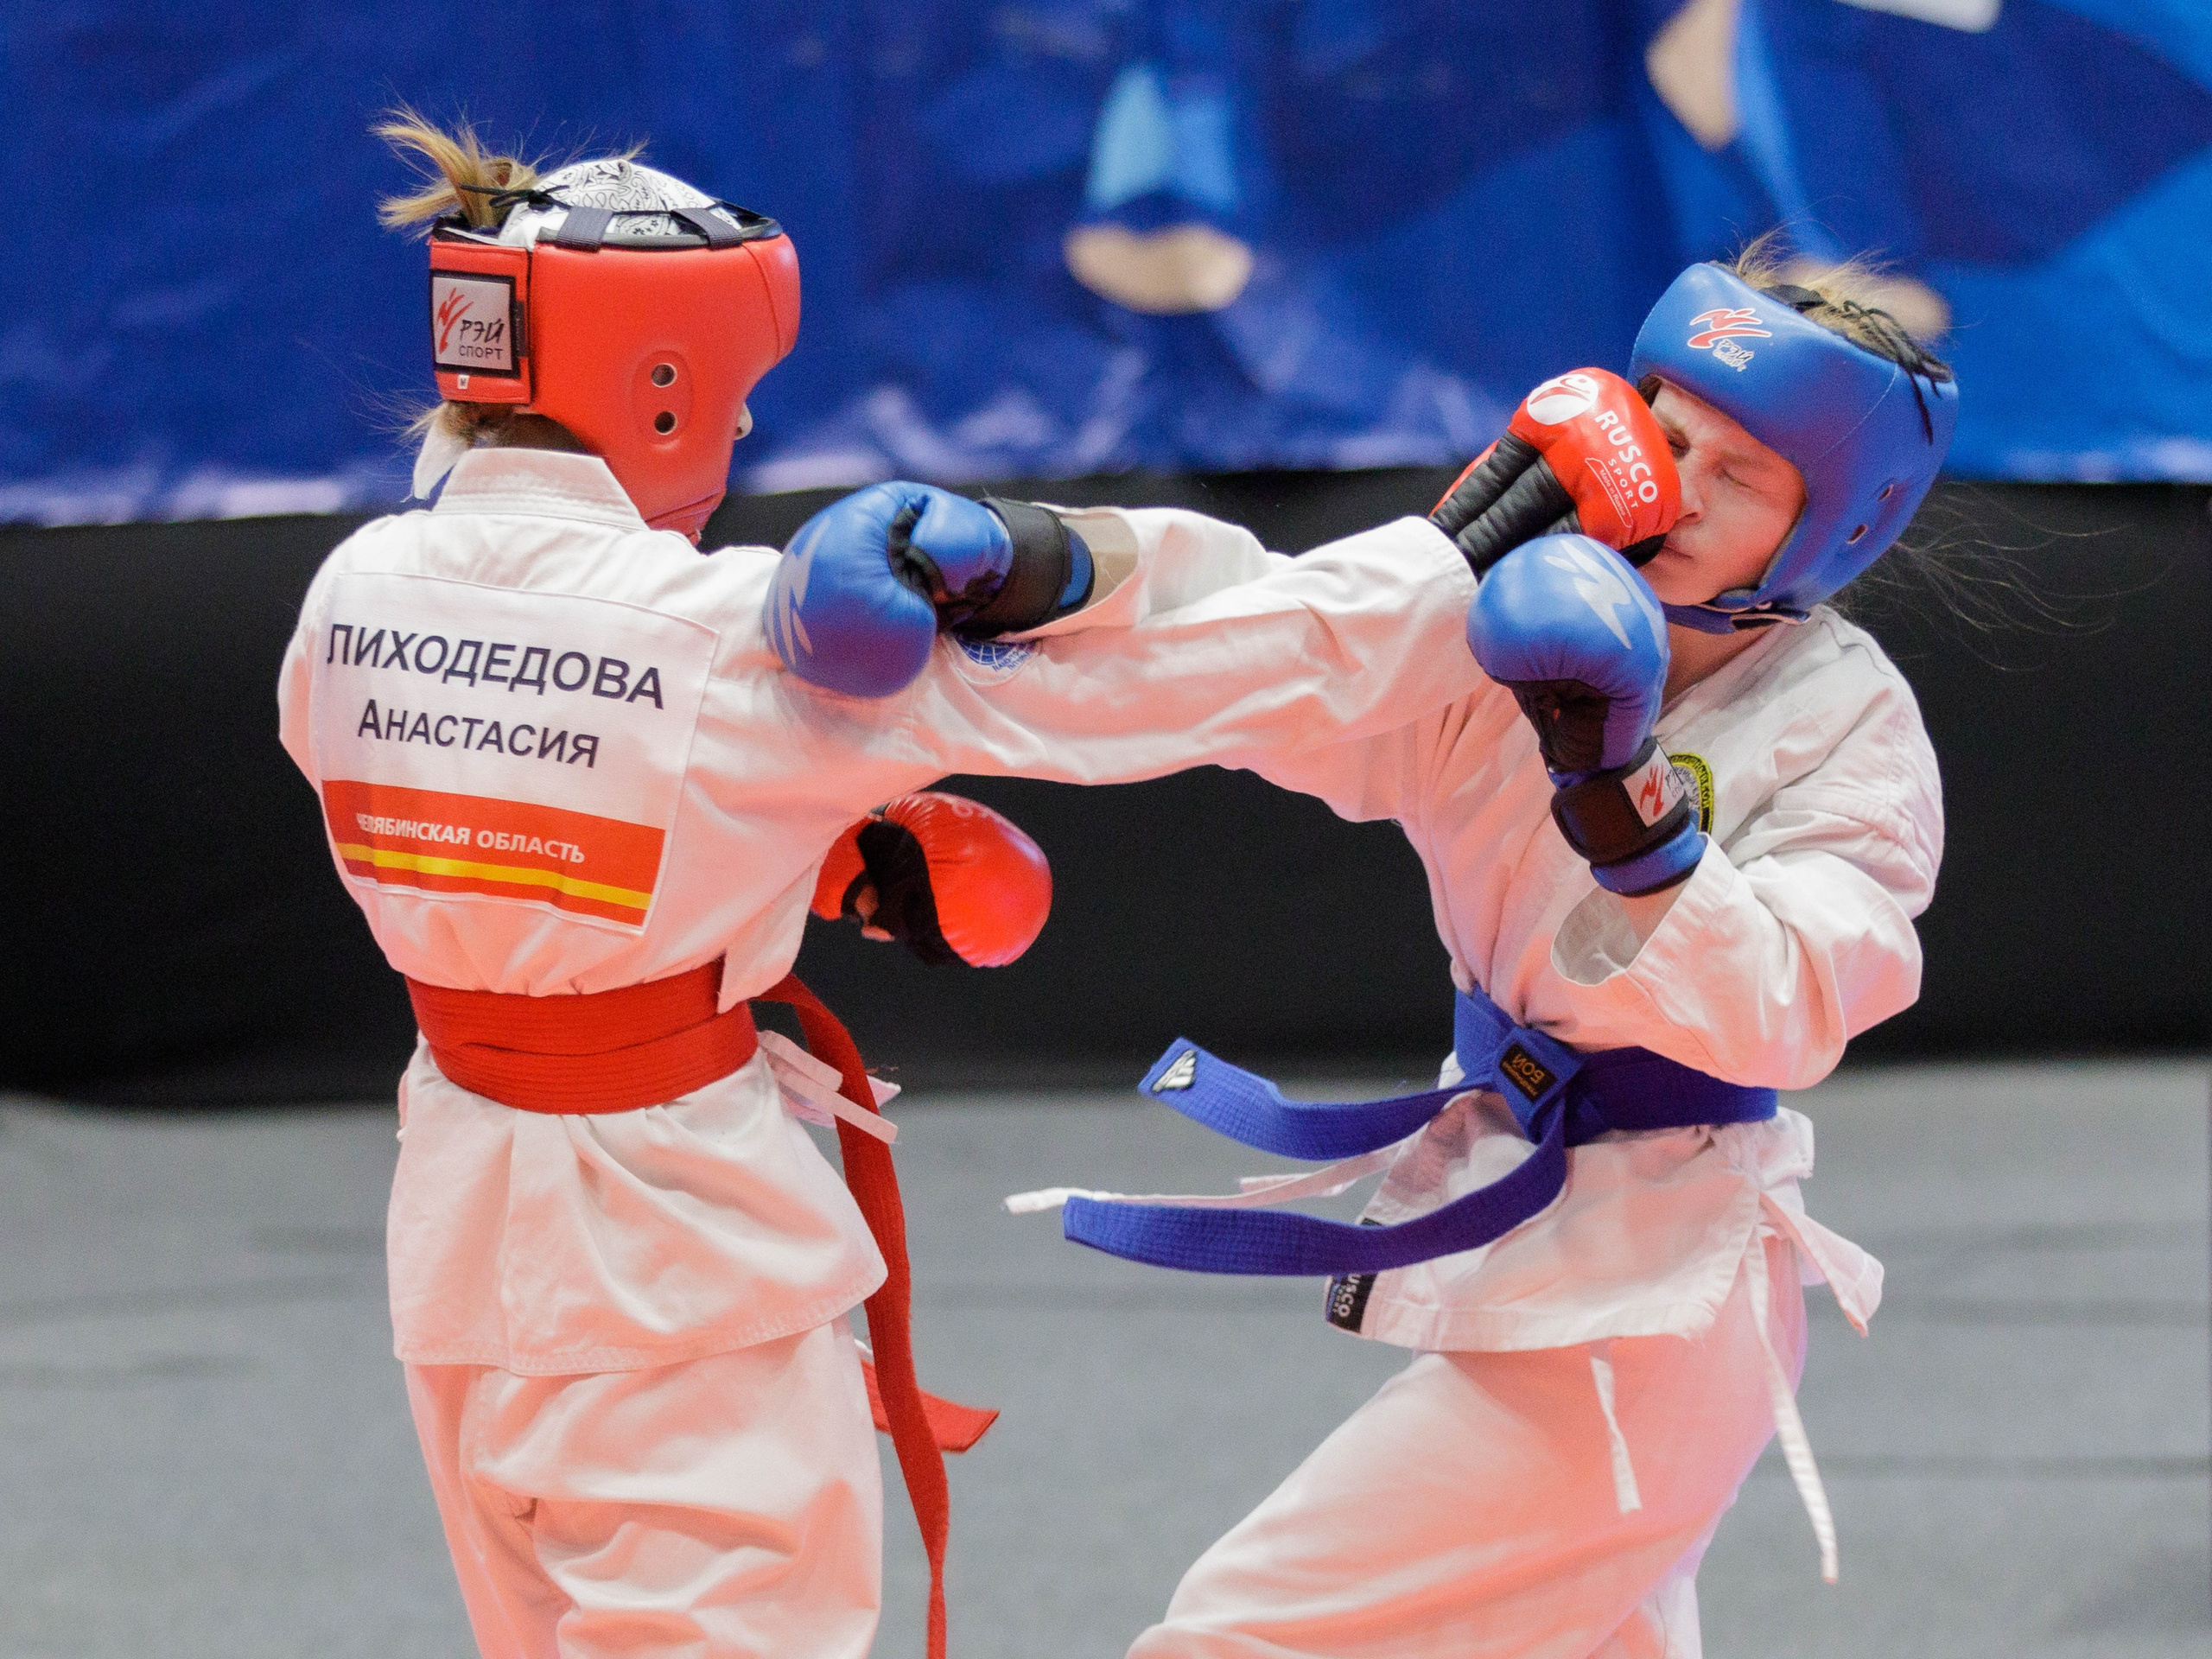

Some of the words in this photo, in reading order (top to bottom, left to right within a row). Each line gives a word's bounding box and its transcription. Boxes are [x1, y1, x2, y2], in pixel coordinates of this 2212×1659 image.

[459, 318, 505, 343] РЭЙ
[1594, 410, 1658, 504] RUSCO
[1607, 458, 1639, 508] SPORT
[327, 624, 664, 709] ЛИХОДЕДОВА
[476, 830, 585, 865] ОБЛАСТЬ
[1338, 1273, 1361, 1318] USCO
